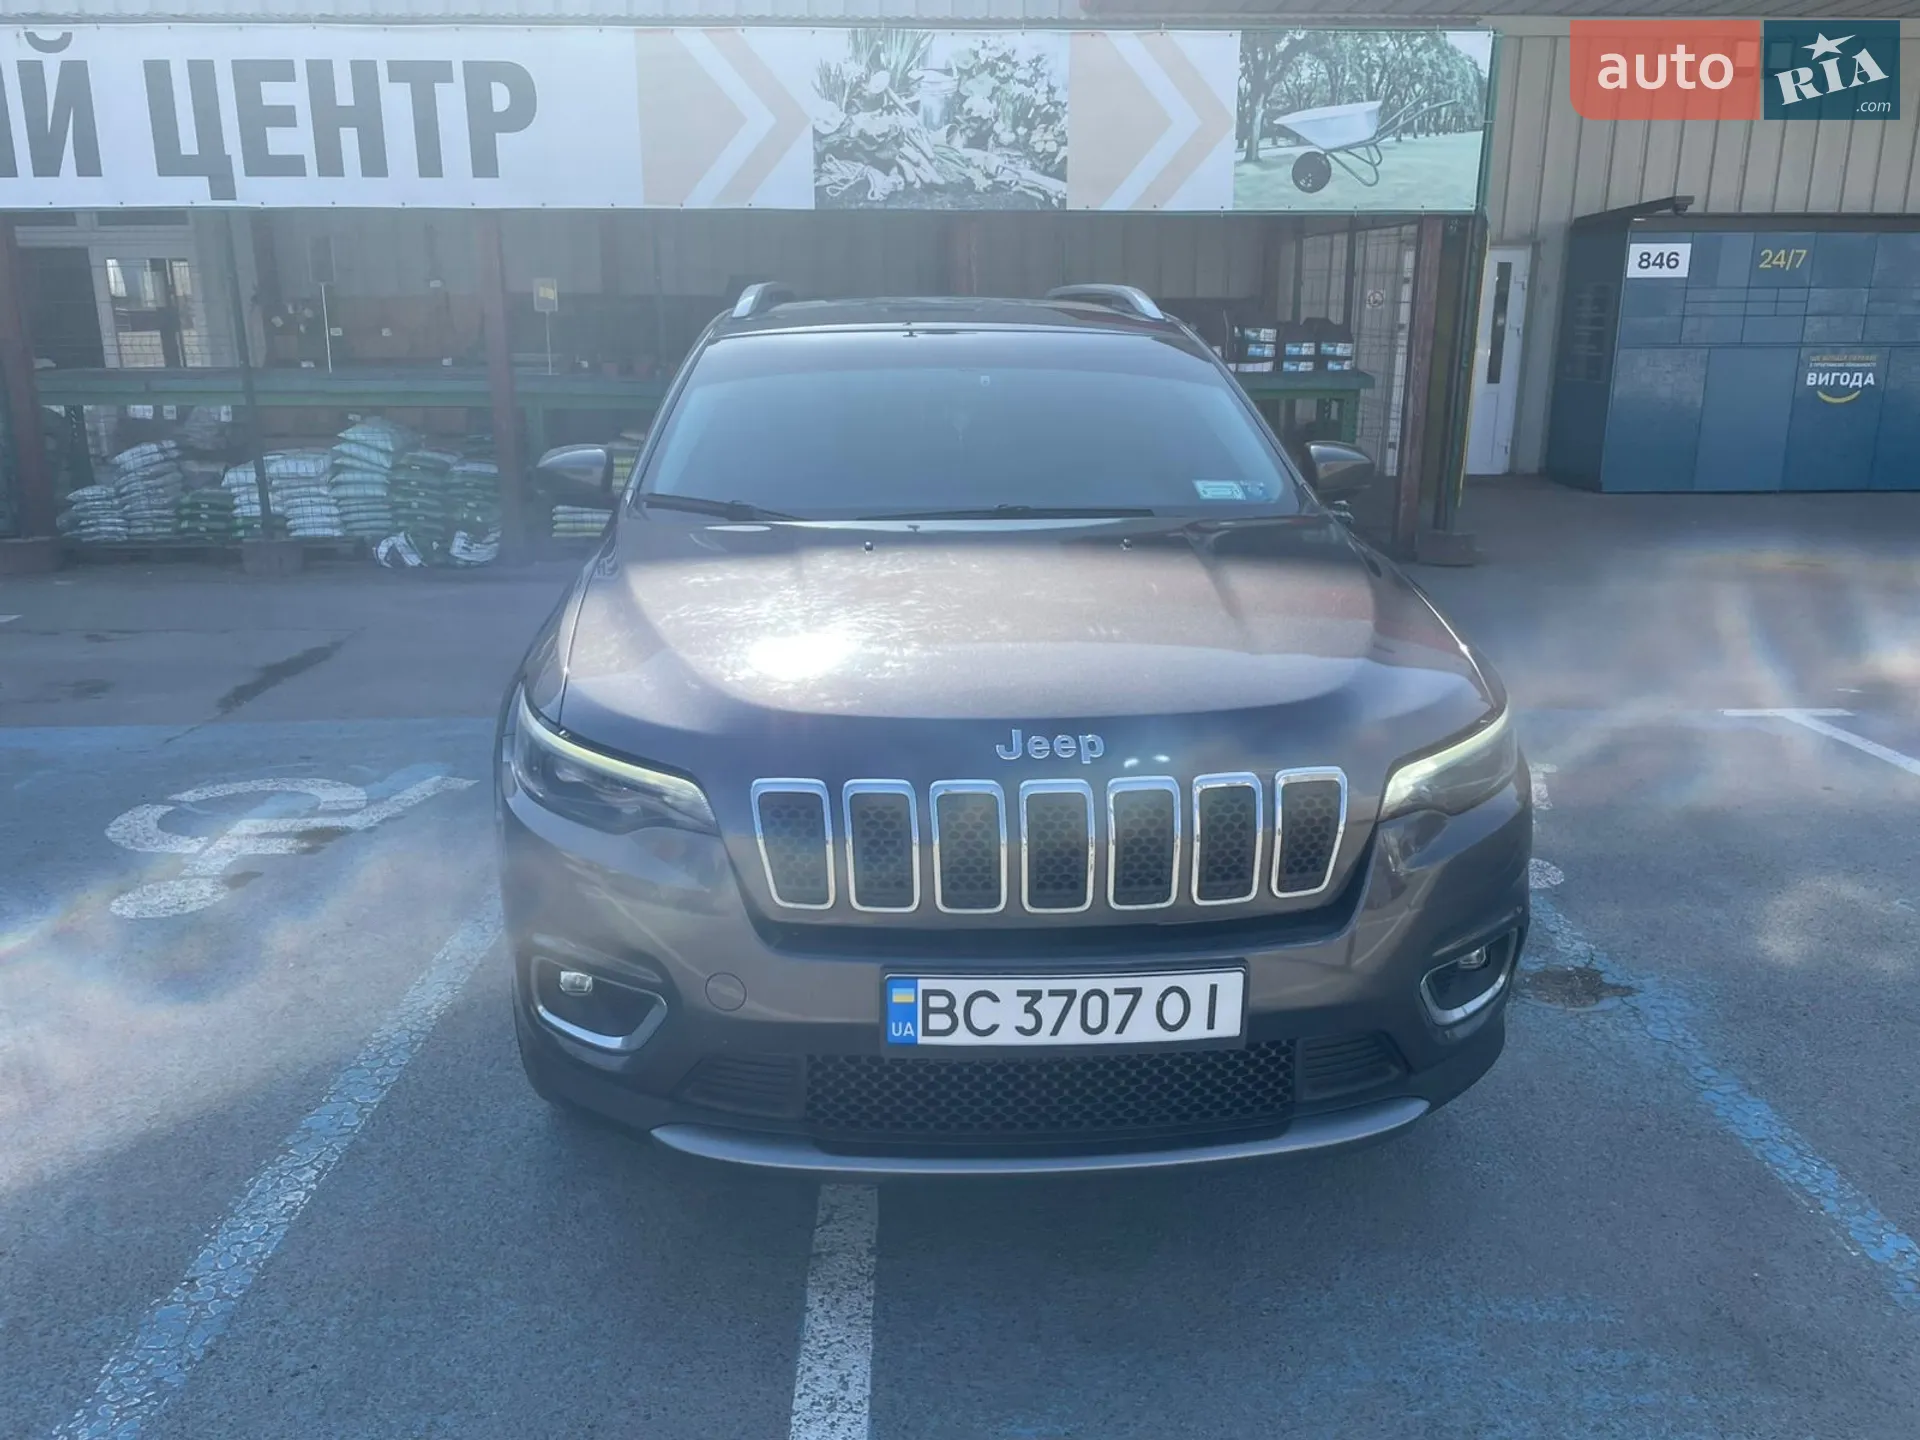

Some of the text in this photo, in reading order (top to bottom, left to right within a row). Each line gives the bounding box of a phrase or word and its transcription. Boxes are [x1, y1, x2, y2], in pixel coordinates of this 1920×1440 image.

[143, 59, 537, 200] ЦЕНТР
[1637, 251, 1681, 270] 846
[1758, 249, 1808, 271] 24/7
[1806, 372, 1875, 388] ВИГОДА
[996, 729, 1105, 764] Jeep
[921, 988, 1001, 1037] BC
[1014, 987, 1143, 1037] 3707
[892, 1021, 915, 1037] UA
